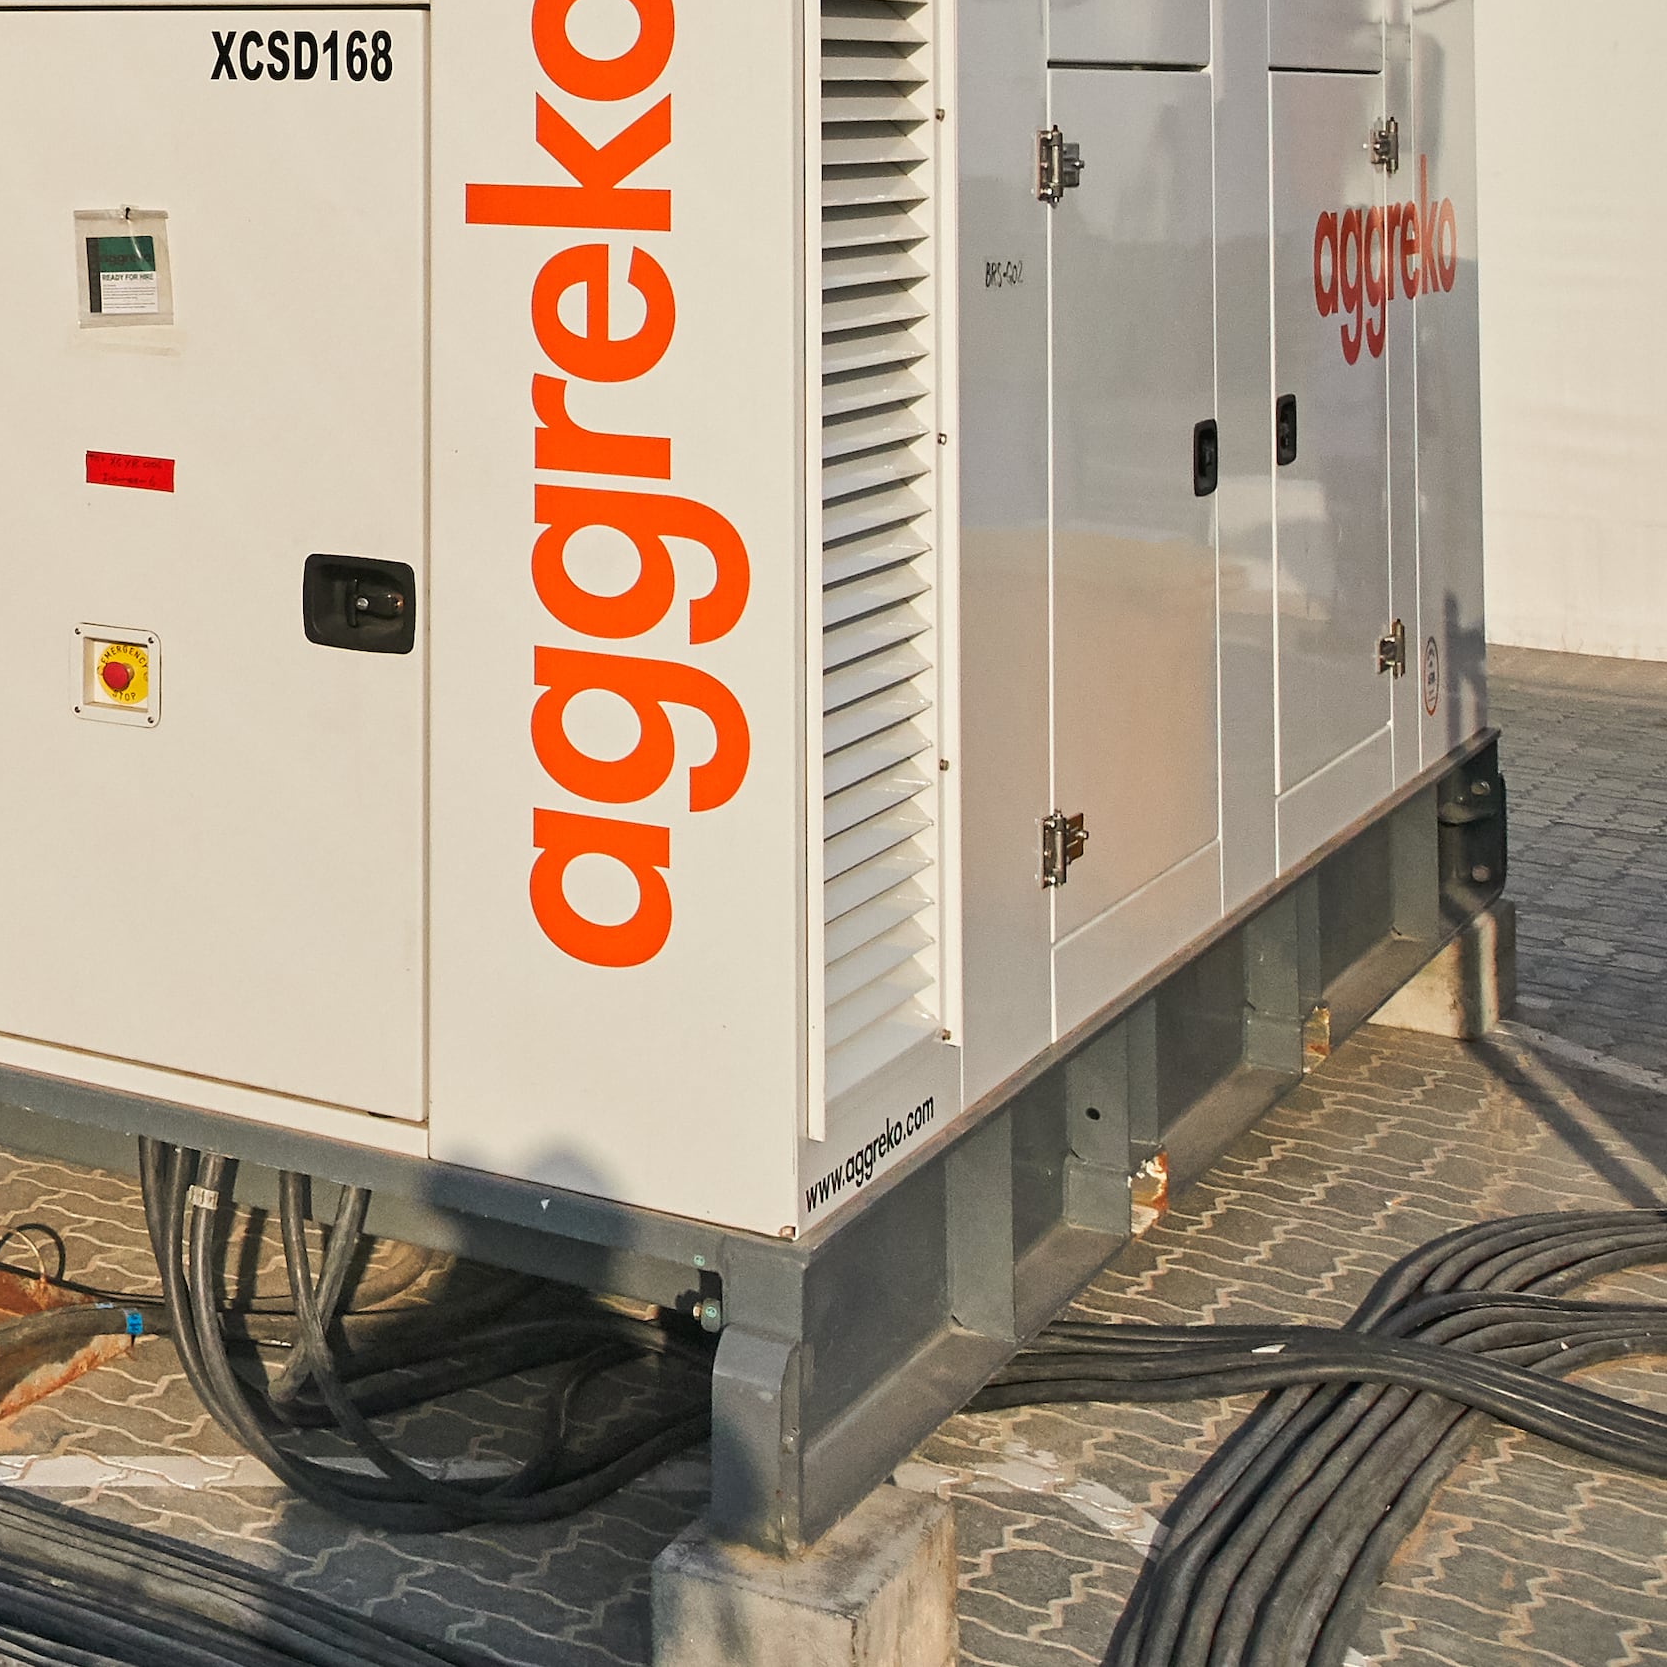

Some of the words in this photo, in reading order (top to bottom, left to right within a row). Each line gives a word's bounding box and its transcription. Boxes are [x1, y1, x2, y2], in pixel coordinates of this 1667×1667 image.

[210, 30, 393, 82] XCSD168
[1314, 153, 1456, 364] aggreko
[101, 645, 148, 669] EMERGENCY
[112, 689, 137, 701] STOP
[805, 1096, 934, 1213] www.aggreko.com
